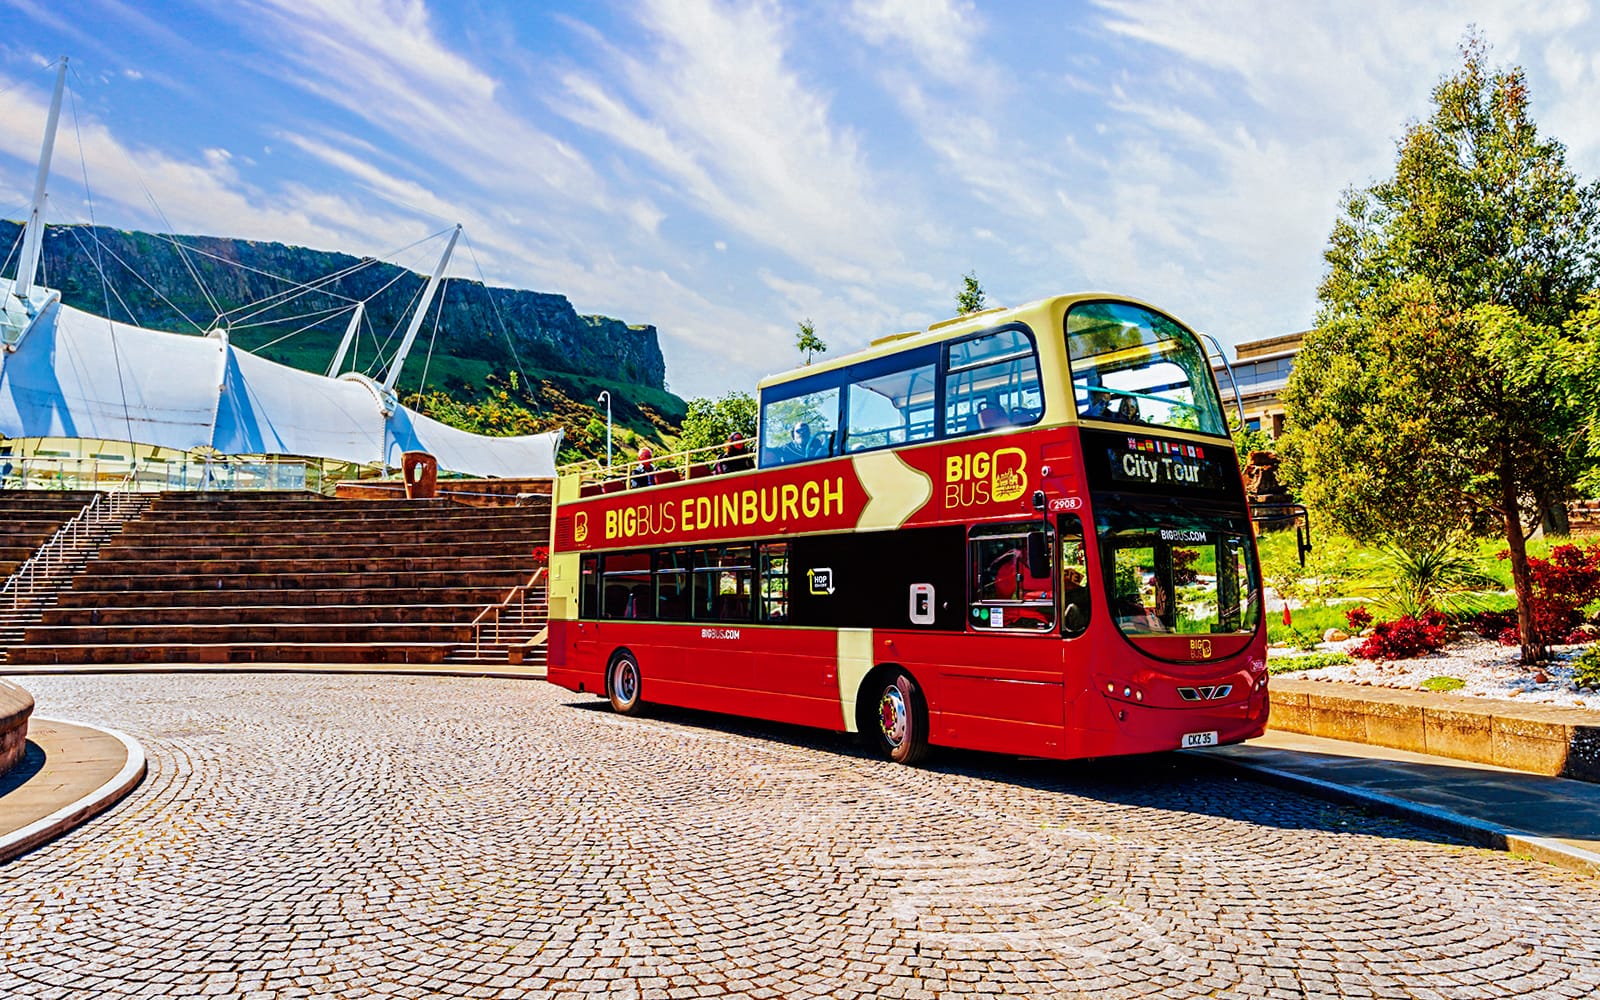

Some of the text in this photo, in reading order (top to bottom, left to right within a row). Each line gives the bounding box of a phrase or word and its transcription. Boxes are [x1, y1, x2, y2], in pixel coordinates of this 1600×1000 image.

[945, 451, 989, 482] BIG
[1122, 453, 1200, 483] City Tour
[945, 480, 990, 509] BUS
[681, 476, 844, 531] EDINBURGH
[1054, 499, 1075, 509] 2908
[1160, 529, 1207, 542] BIGBUS.COM
[814, 575, 827, 584] HOP
[701, 628, 740, 640] BIGBUS.COM
[1190, 639, 1202, 649] BIG
[1190, 650, 1203, 659] BUS
[1188, 732, 1211, 746] CKZ 35
